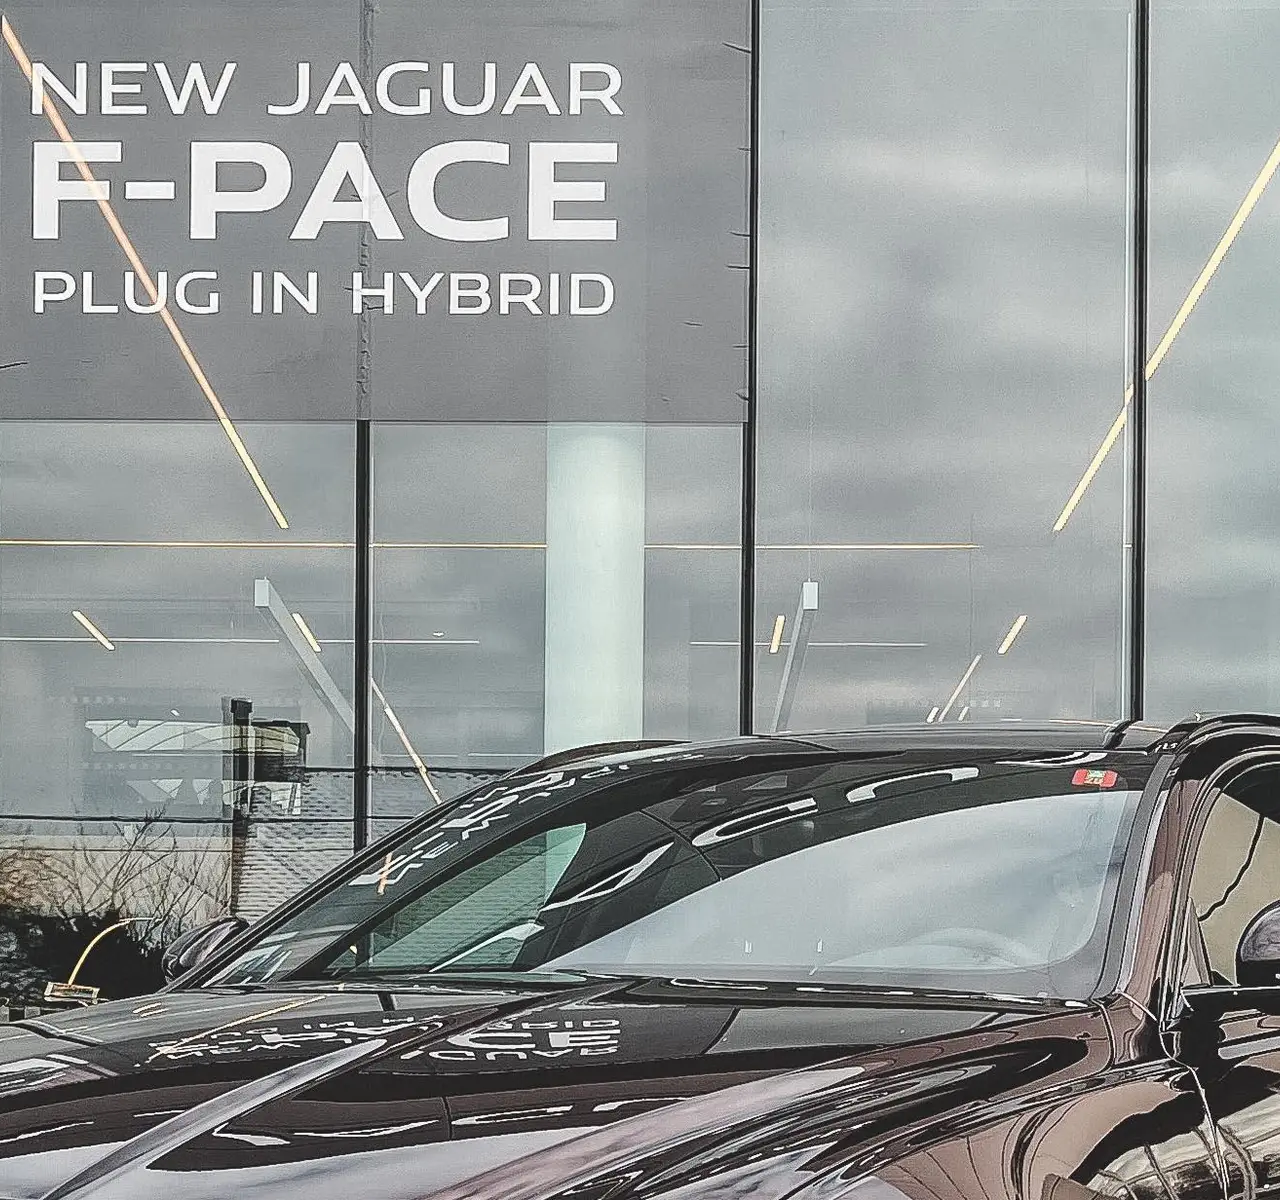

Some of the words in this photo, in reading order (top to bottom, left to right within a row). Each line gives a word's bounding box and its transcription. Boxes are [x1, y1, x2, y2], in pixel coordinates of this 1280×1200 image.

[31, 61, 237, 117] NEW
[267, 61, 624, 117] JAGUAR
[32, 140, 619, 242] F-PACE
[34, 270, 221, 316] PLUG
[252, 271, 319, 315] IN
[351, 272, 616, 317] HYBRID
